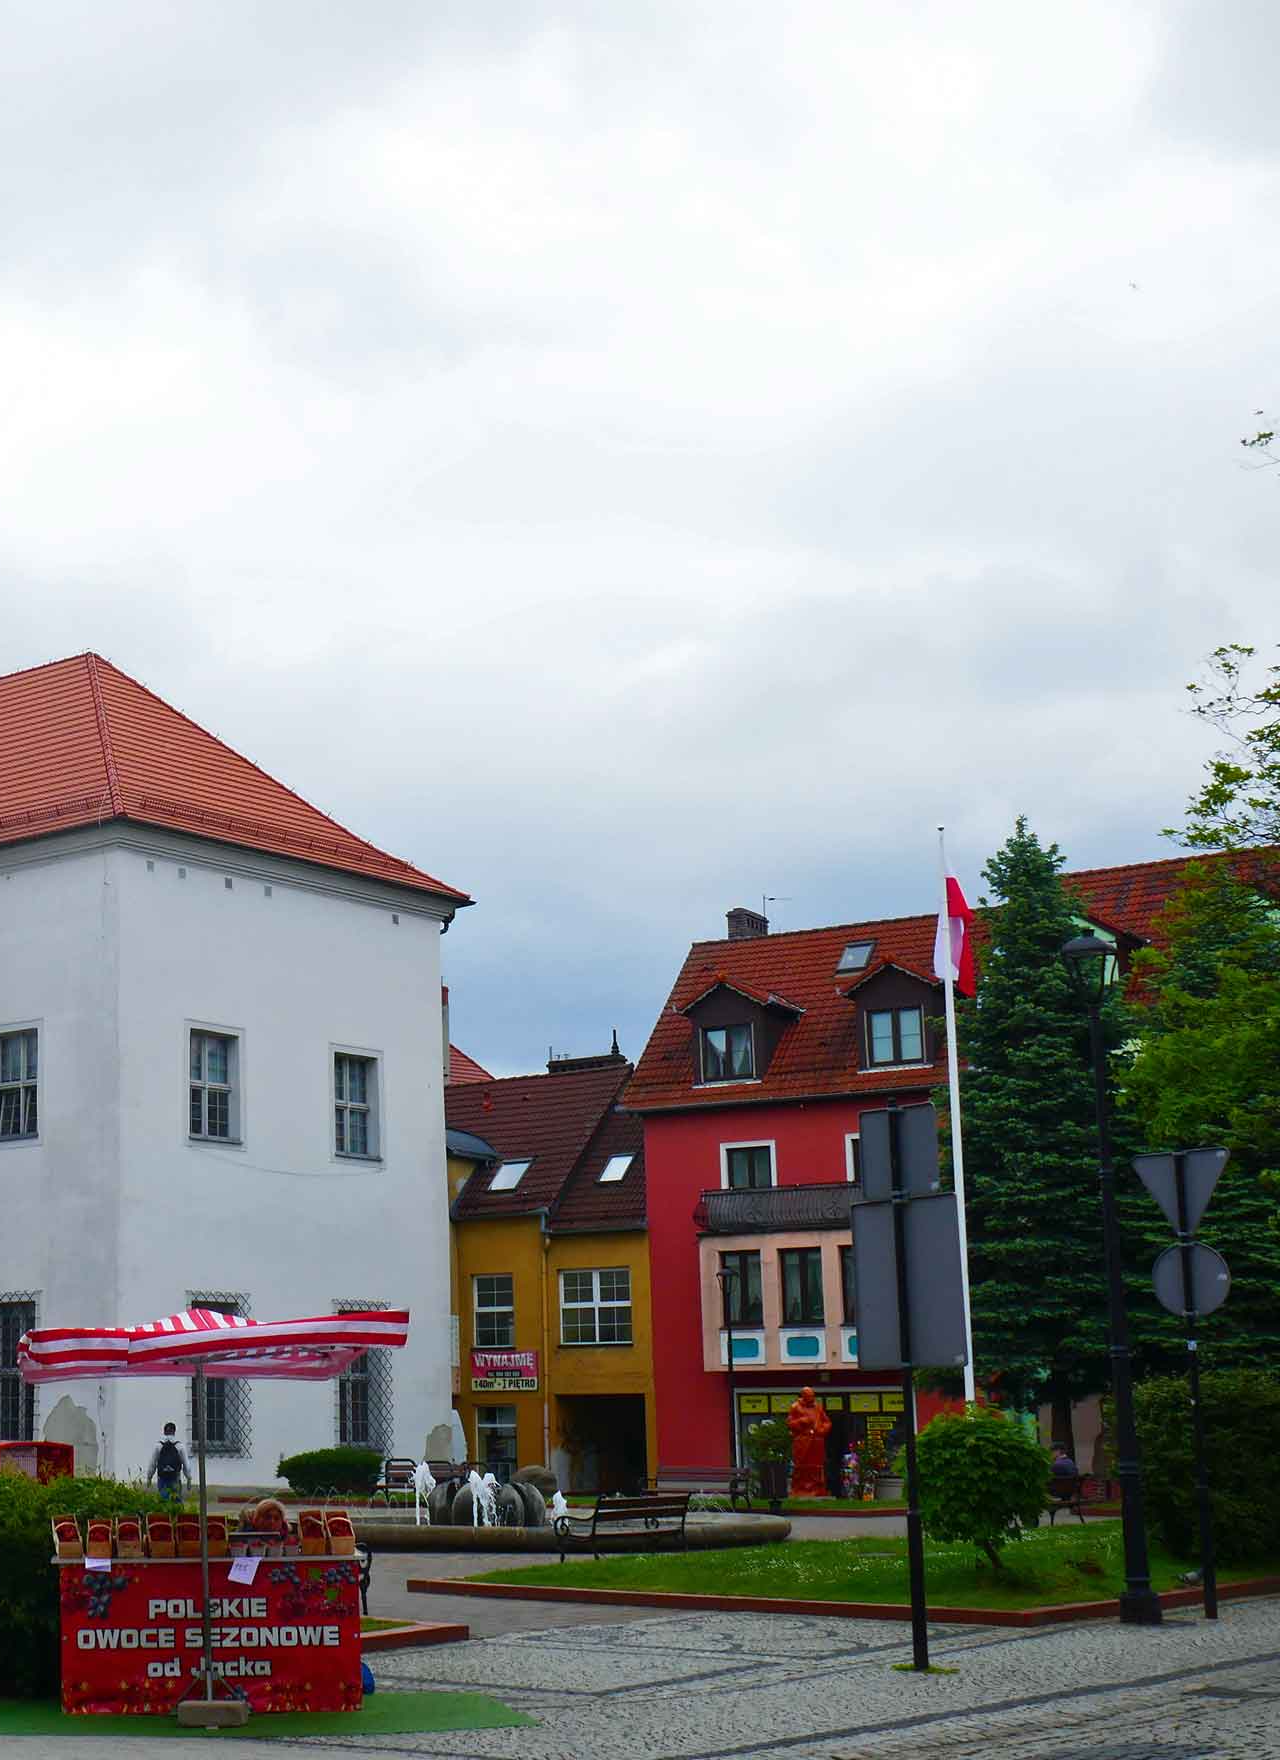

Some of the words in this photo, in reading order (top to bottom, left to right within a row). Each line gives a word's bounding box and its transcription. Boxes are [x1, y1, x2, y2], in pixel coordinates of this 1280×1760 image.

[148, 1597, 267, 1619] POLSKIE
[77, 1628, 175, 1649] OWOCE
[185, 1625, 340, 1648] SEZONOWE
[147, 1656, 182, 1677] od
[191, 1656, 272, 1679] Jacka
